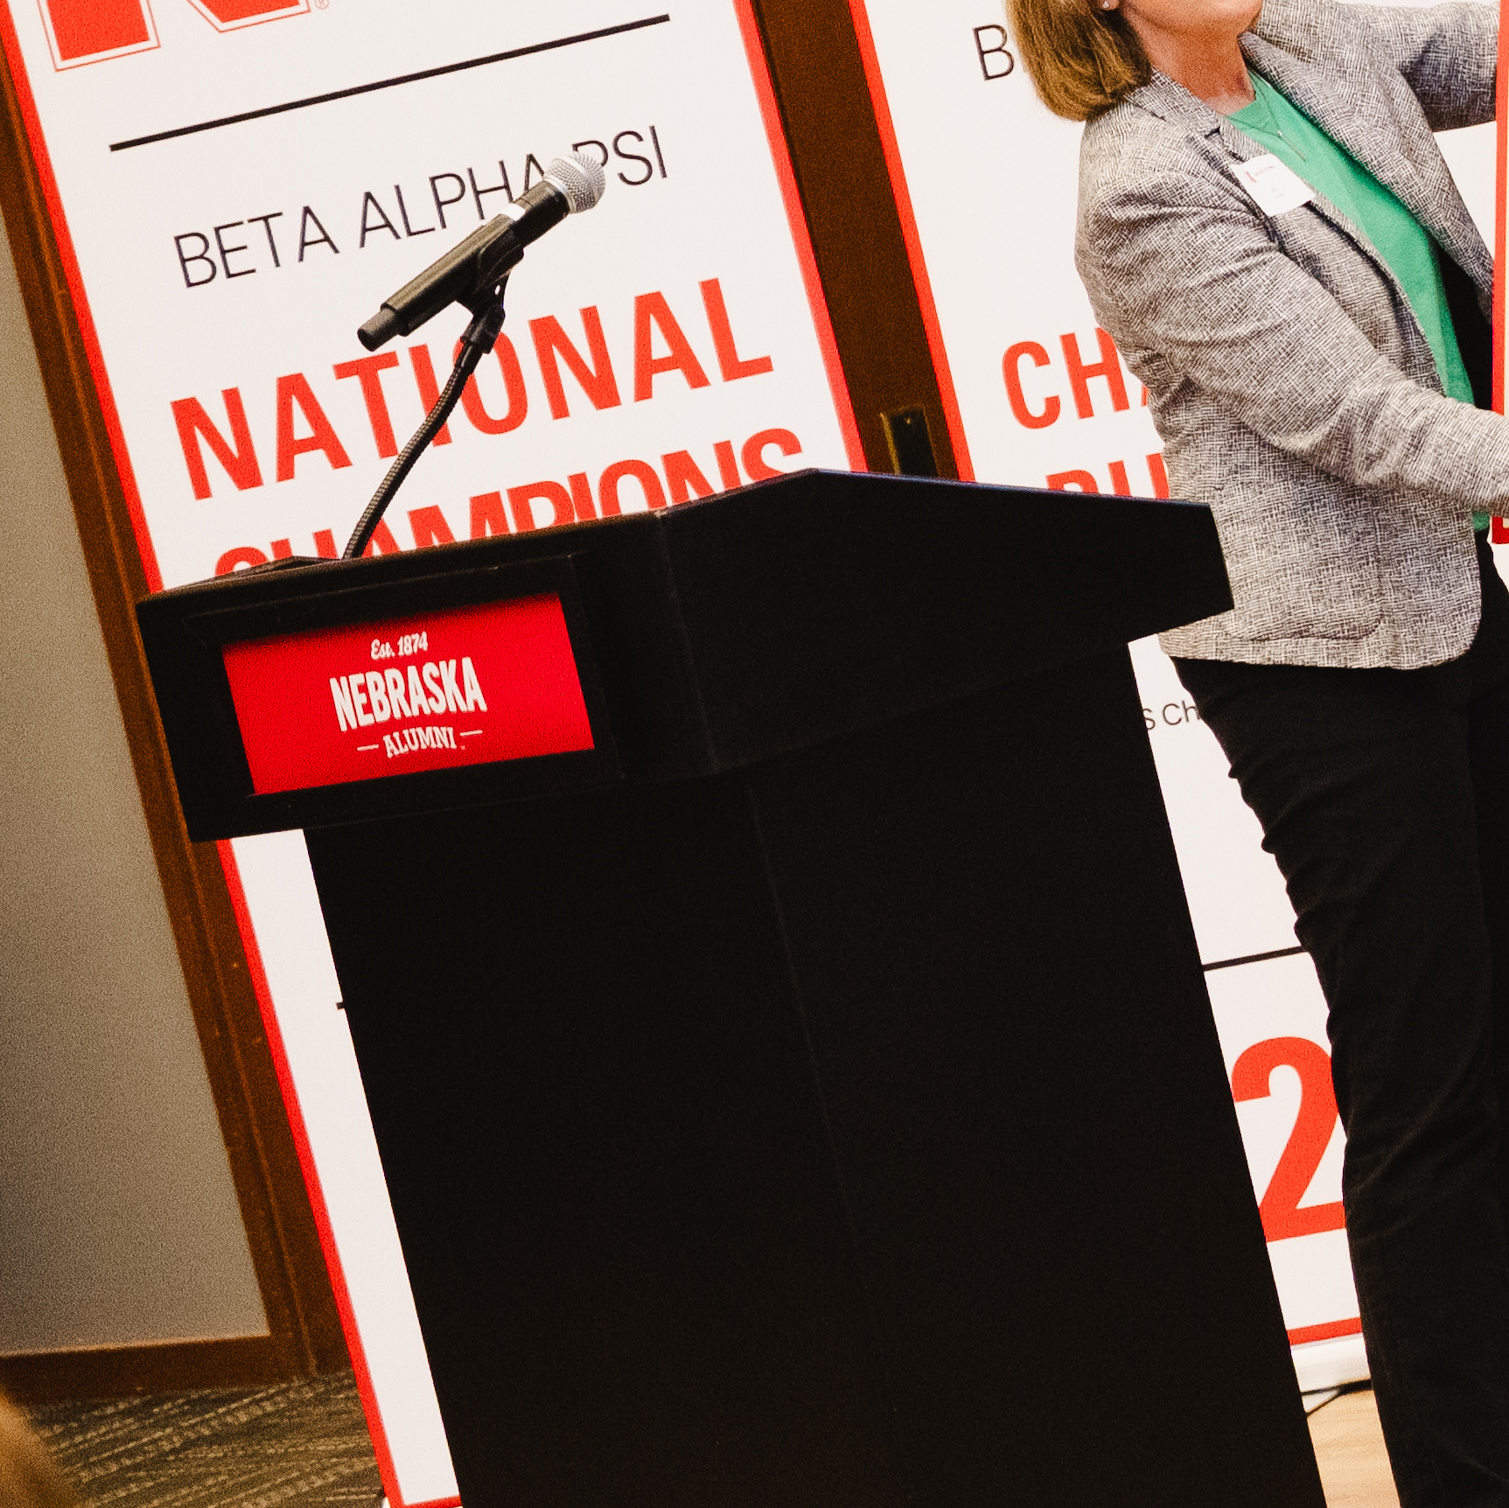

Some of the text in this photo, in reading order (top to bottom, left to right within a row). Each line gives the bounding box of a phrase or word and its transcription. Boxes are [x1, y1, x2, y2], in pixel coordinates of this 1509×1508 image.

[173, 204, 339, 289] BETA
[169, 277, 774, 500] NATIONAL
[370, 631, 428, 660] Est. 1874
[329, 656, 488, 732] NEBRASKA
[382, 726, 458, 758] ALUMNI
